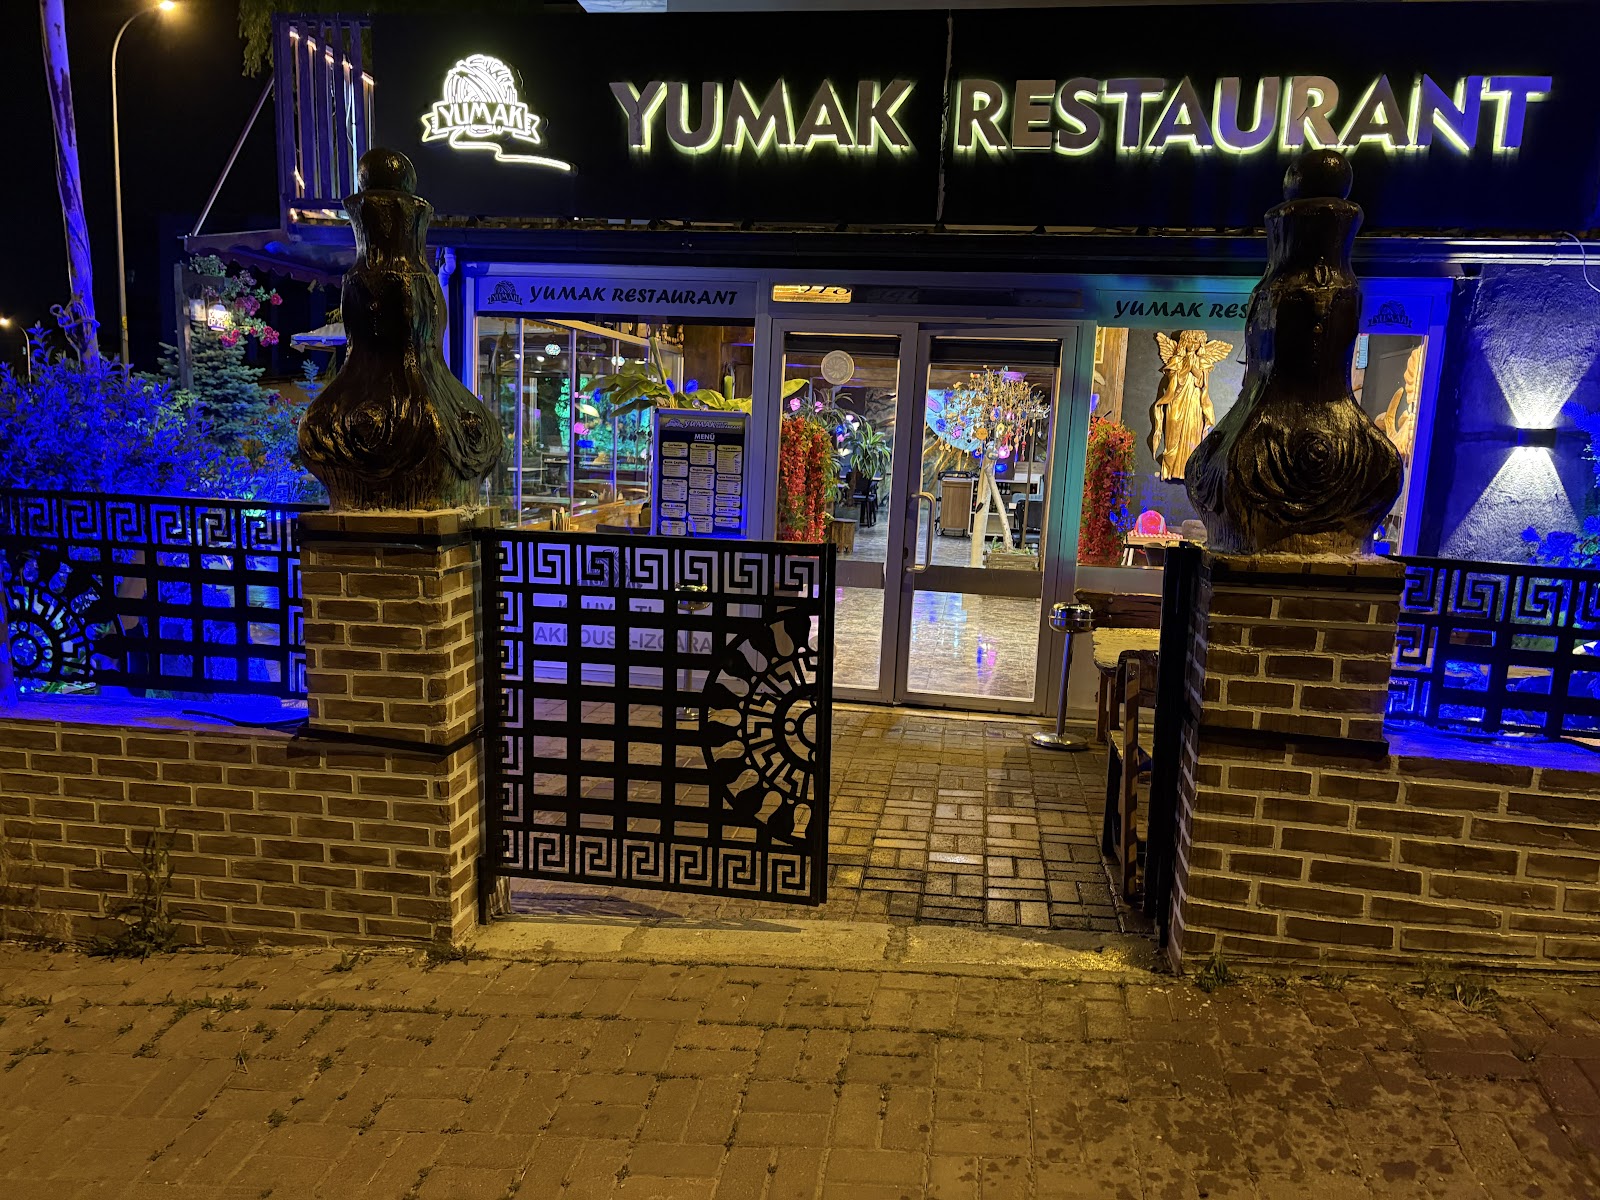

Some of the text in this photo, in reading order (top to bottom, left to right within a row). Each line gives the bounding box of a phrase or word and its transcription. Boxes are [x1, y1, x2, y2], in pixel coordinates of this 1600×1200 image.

[438, 102, 523, 130] YUMAK
[609, 73, 1552, 154] YUMAK RESTAURANT
[530, 285, 738, 306] YUMAK RESTAURANT
[1113, 300, 1249, 319] YUMAK RES
[694, 432, 715, 441] MENÜ
